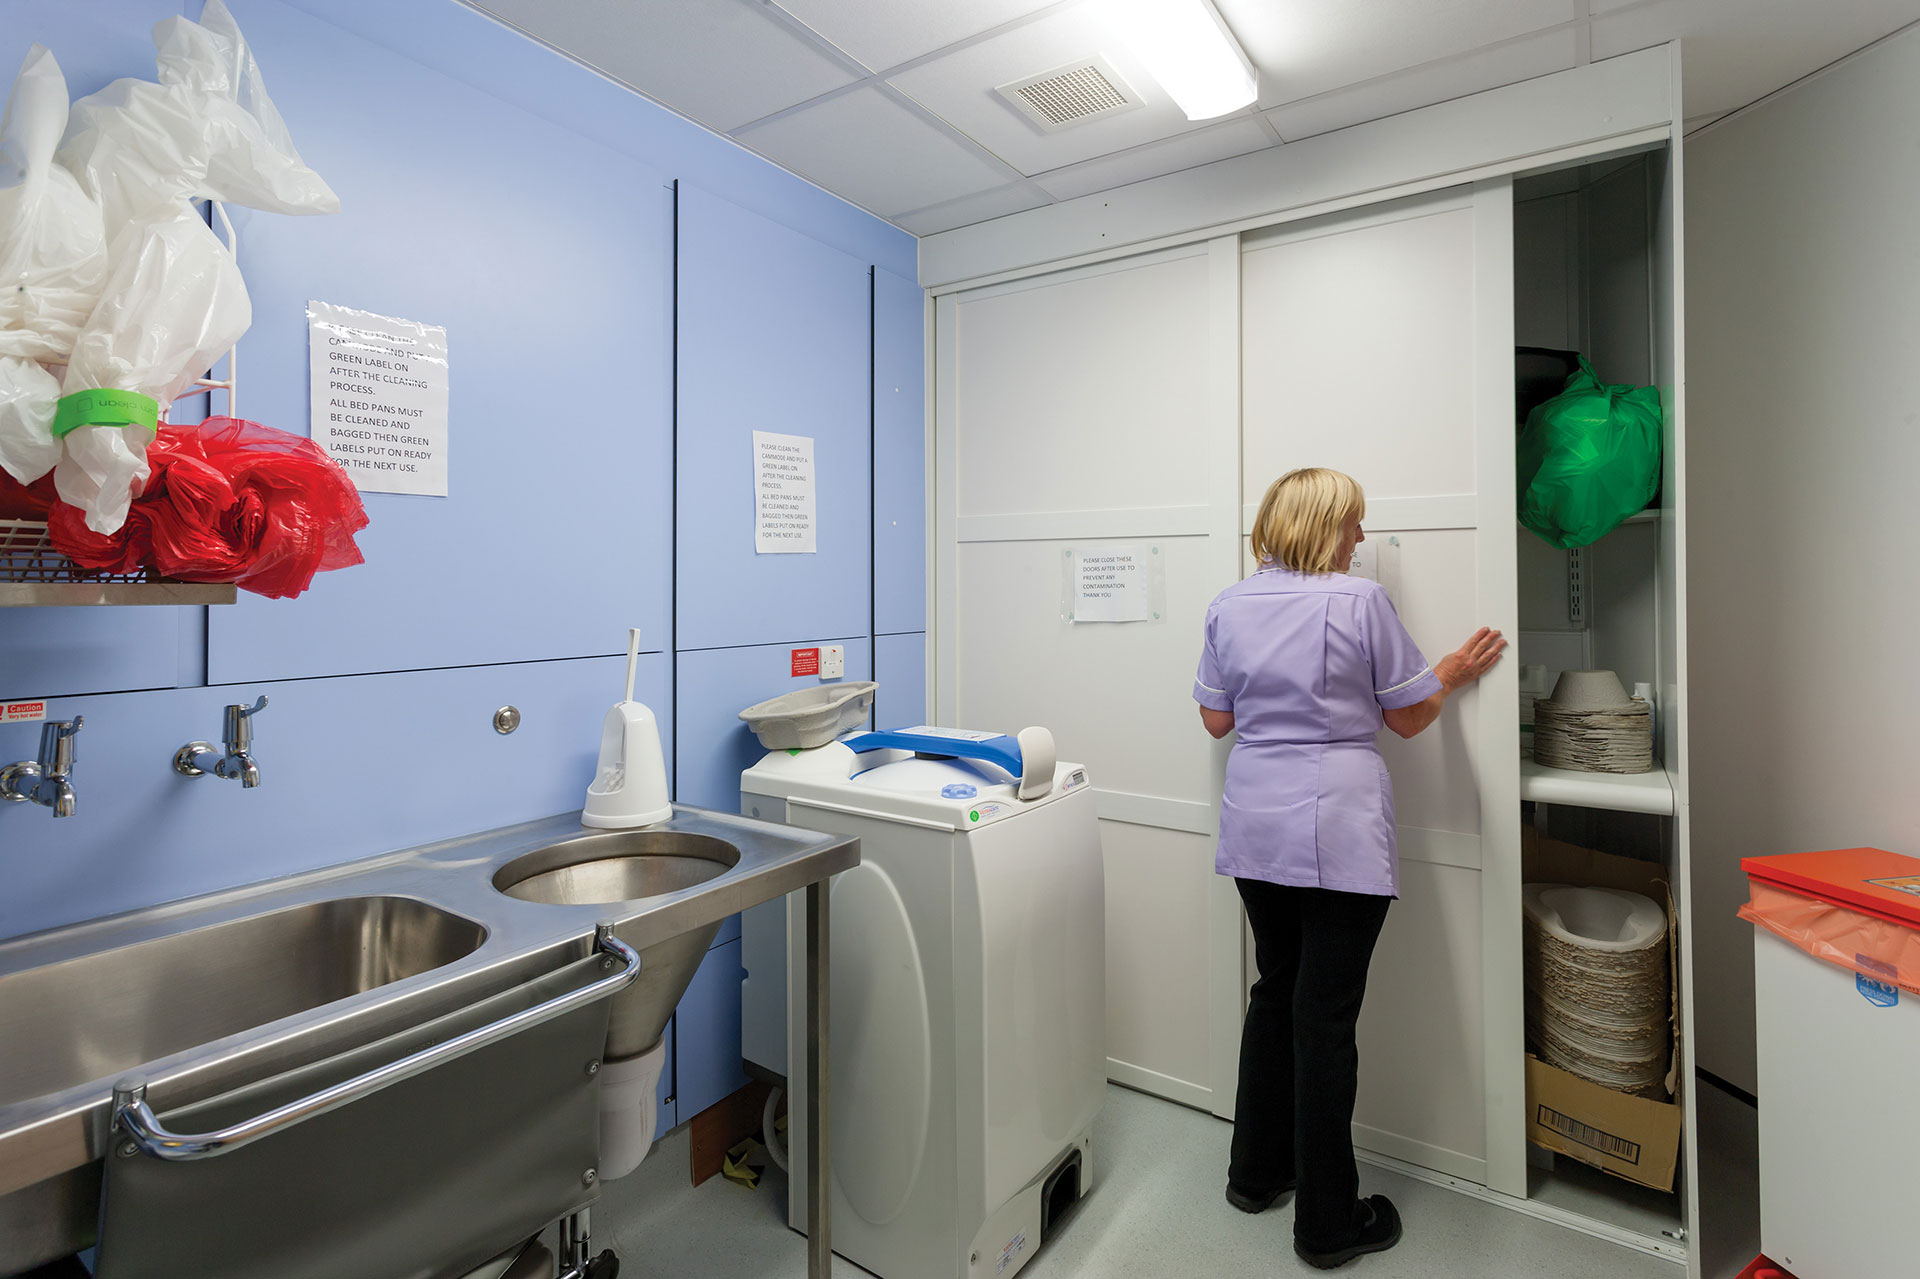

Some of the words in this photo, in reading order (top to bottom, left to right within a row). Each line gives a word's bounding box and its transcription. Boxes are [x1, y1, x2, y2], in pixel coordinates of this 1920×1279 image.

[384, 345, 404, 358] AND
[330, 352, 361, 365] GREEN
[365, 357, 392, 369] LABEL
[395, 362, 409, 372] ON
[330, 367, 359, 379] AFTER
[362, 372, 380, 382] THE
[383, 375, 428, 389] CLEANING
[331, 382, 375, 395] PROCESS.
[98, 400, 137, 409] clean
[330, 399, 347, 408] ALL
[350, 401, 368, 411] BED
[372, 404, 395, 414] PANS
[398, 407, 423, 418] MUST
[331, 413, 342, 422] BE
[345, 415, 388, 427] CLEANED
[391, 420, 410, 429] AND
[331, 429, 371, 440] BAGGED
[374, 433, 398, 443] THEN
[401, 436, 429, 446] GREEN
[331, 443, 364, 454] LABELS
[368, 447, 385, 456] PUT
[388, 448, 401, 457] ON
[404, 450, 431, 459] READY
[331, 458, 349, 467] OR
[354, 460, 370, 469] THE
[374, 462, 396, 471] NEXT
[400, 464, 418, 472] USE.
